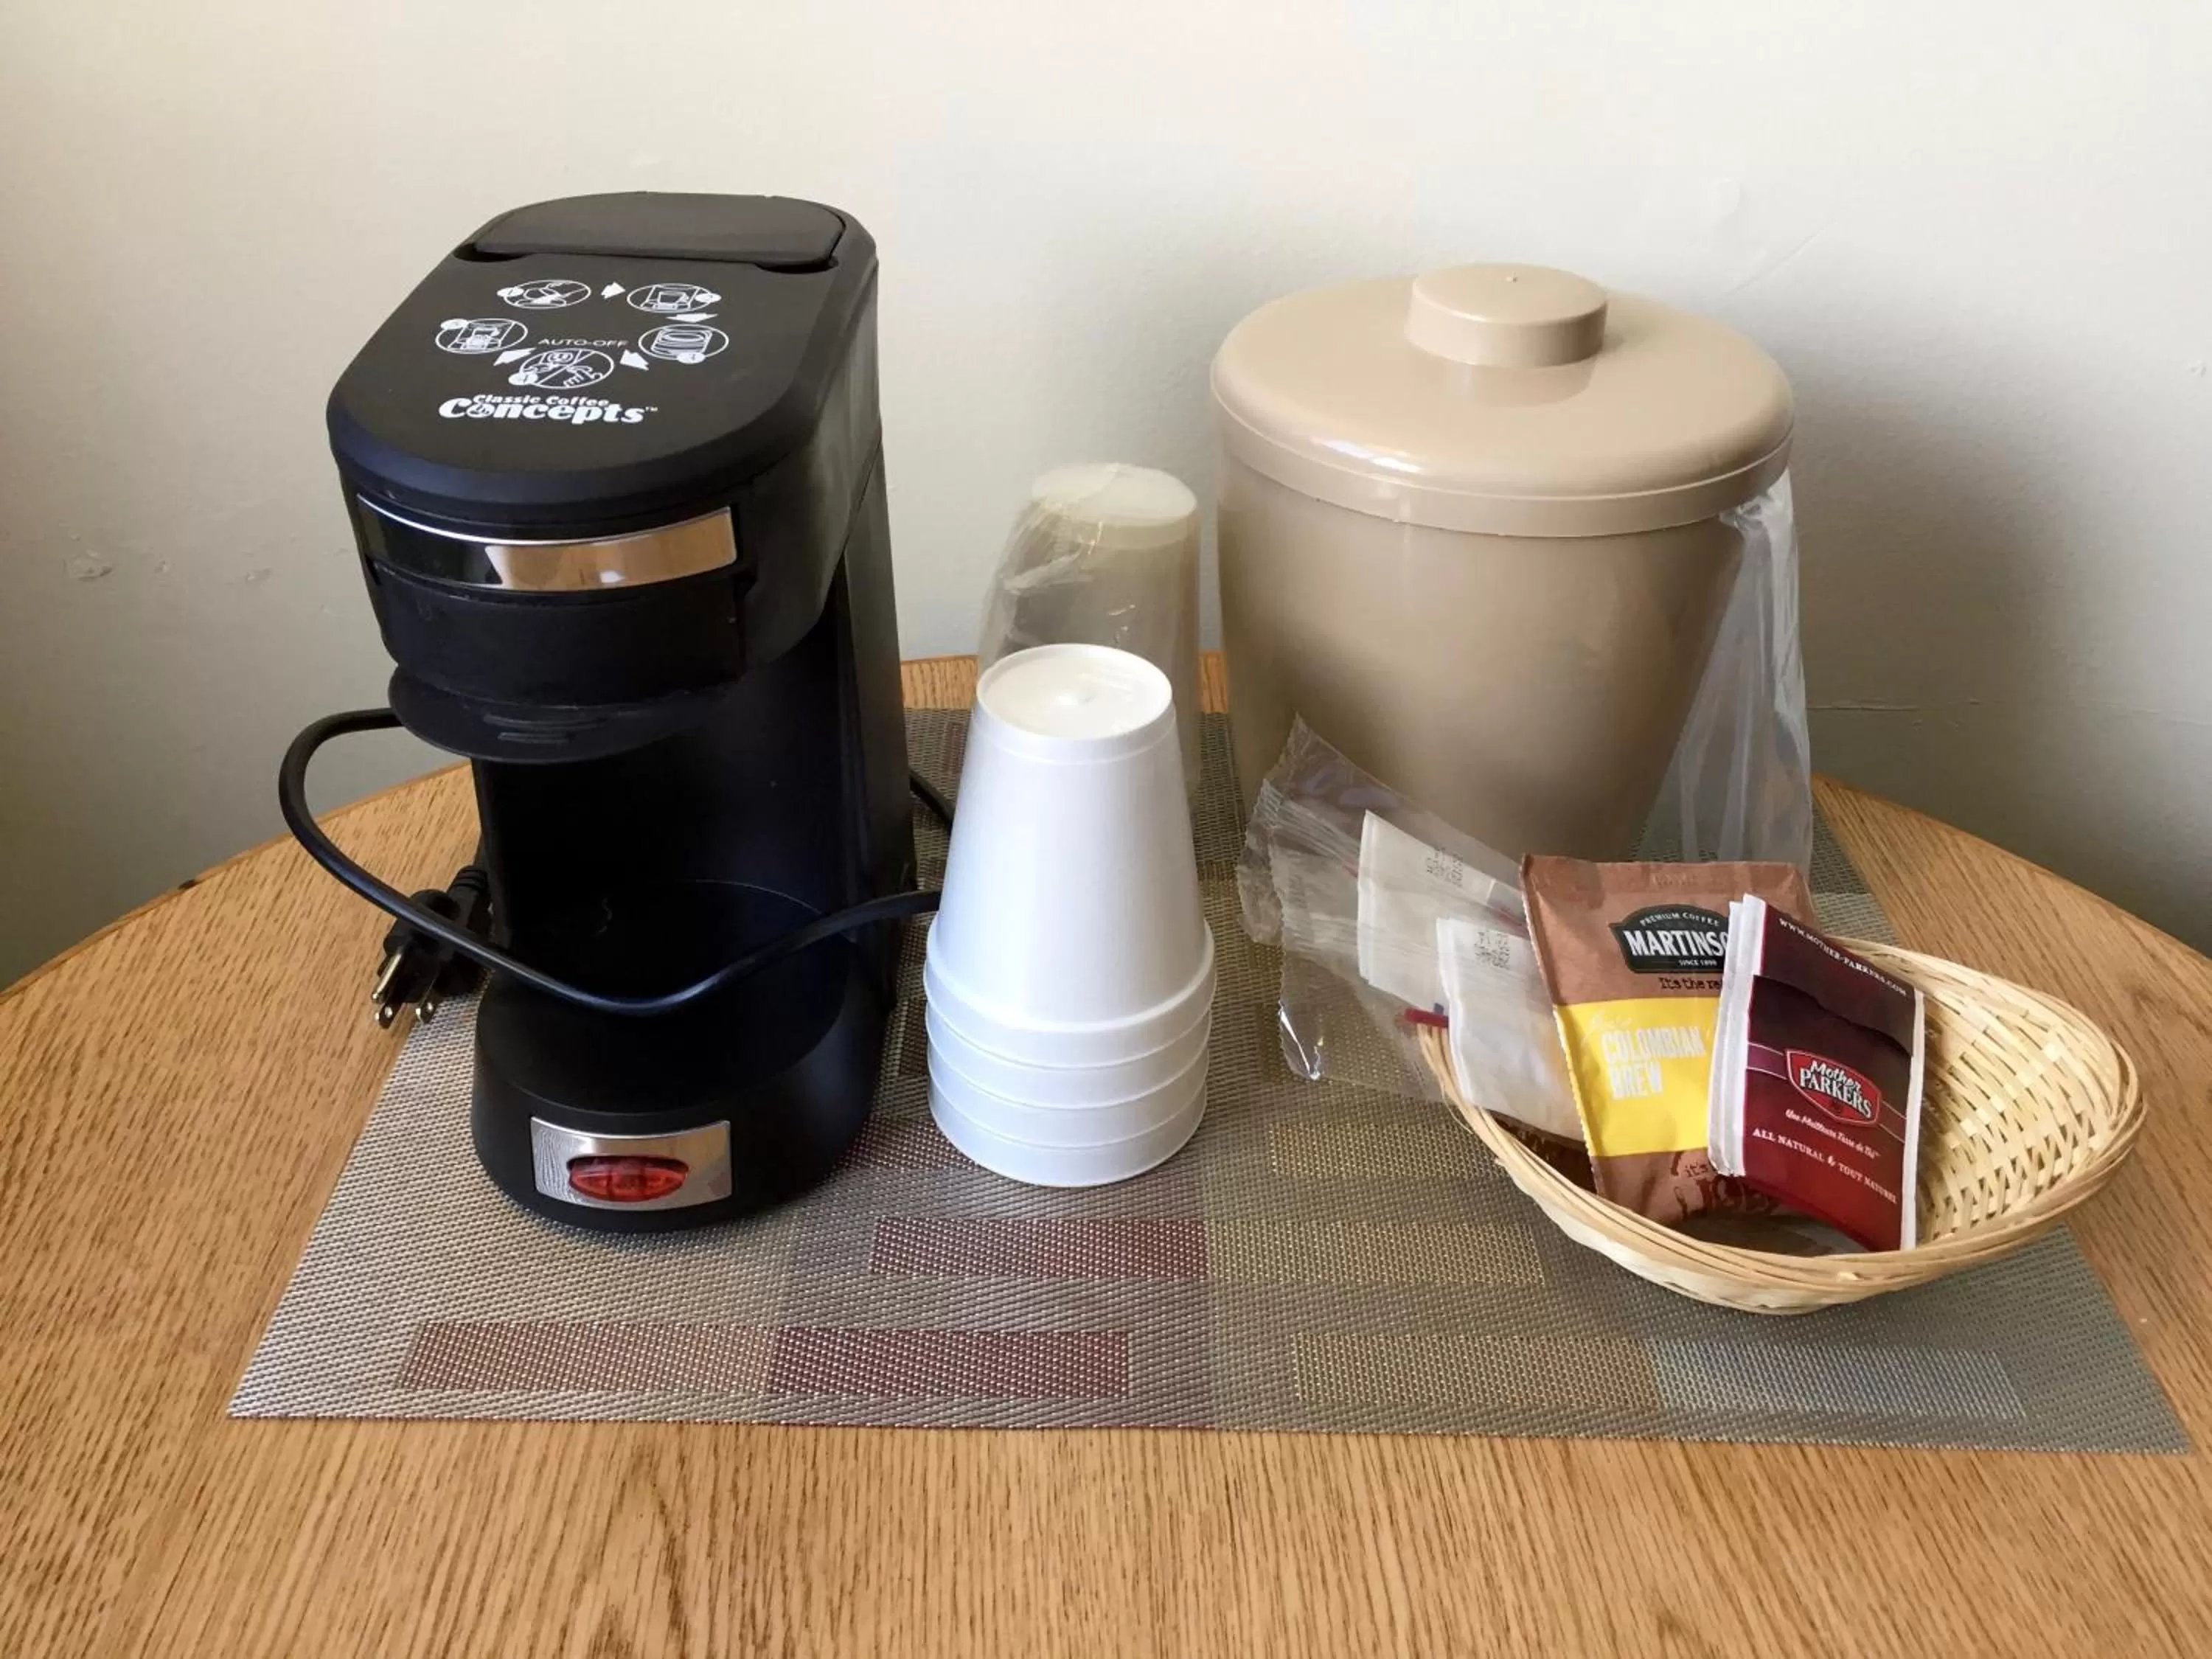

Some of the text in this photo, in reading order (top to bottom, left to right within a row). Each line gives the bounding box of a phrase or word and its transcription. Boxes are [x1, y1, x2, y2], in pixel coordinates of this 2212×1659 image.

[538, 338, 628, 348] AUTO-OFF
[439, 397, 645, 425] Concepts
[473, 394, 610, 407] Classic Coffee
[1639, 911, 1720, 927] PREMIUM COFFEE
[1623, 930, 1729, 957] MARTINSO
[1682, 977, 1705, 990] the
[1601, 1025, 1706, 1063] COLOMBIAN
[1608, 1061, 1663, 1099] BREW
[1810, 1060, 1862, 1093] Mother
[1799, 1067, 1871, 1119] PARKERS
[1752, 1127, 1777, 1142] ALL
[1778, 1135, 1826, 1162] NATURAL
